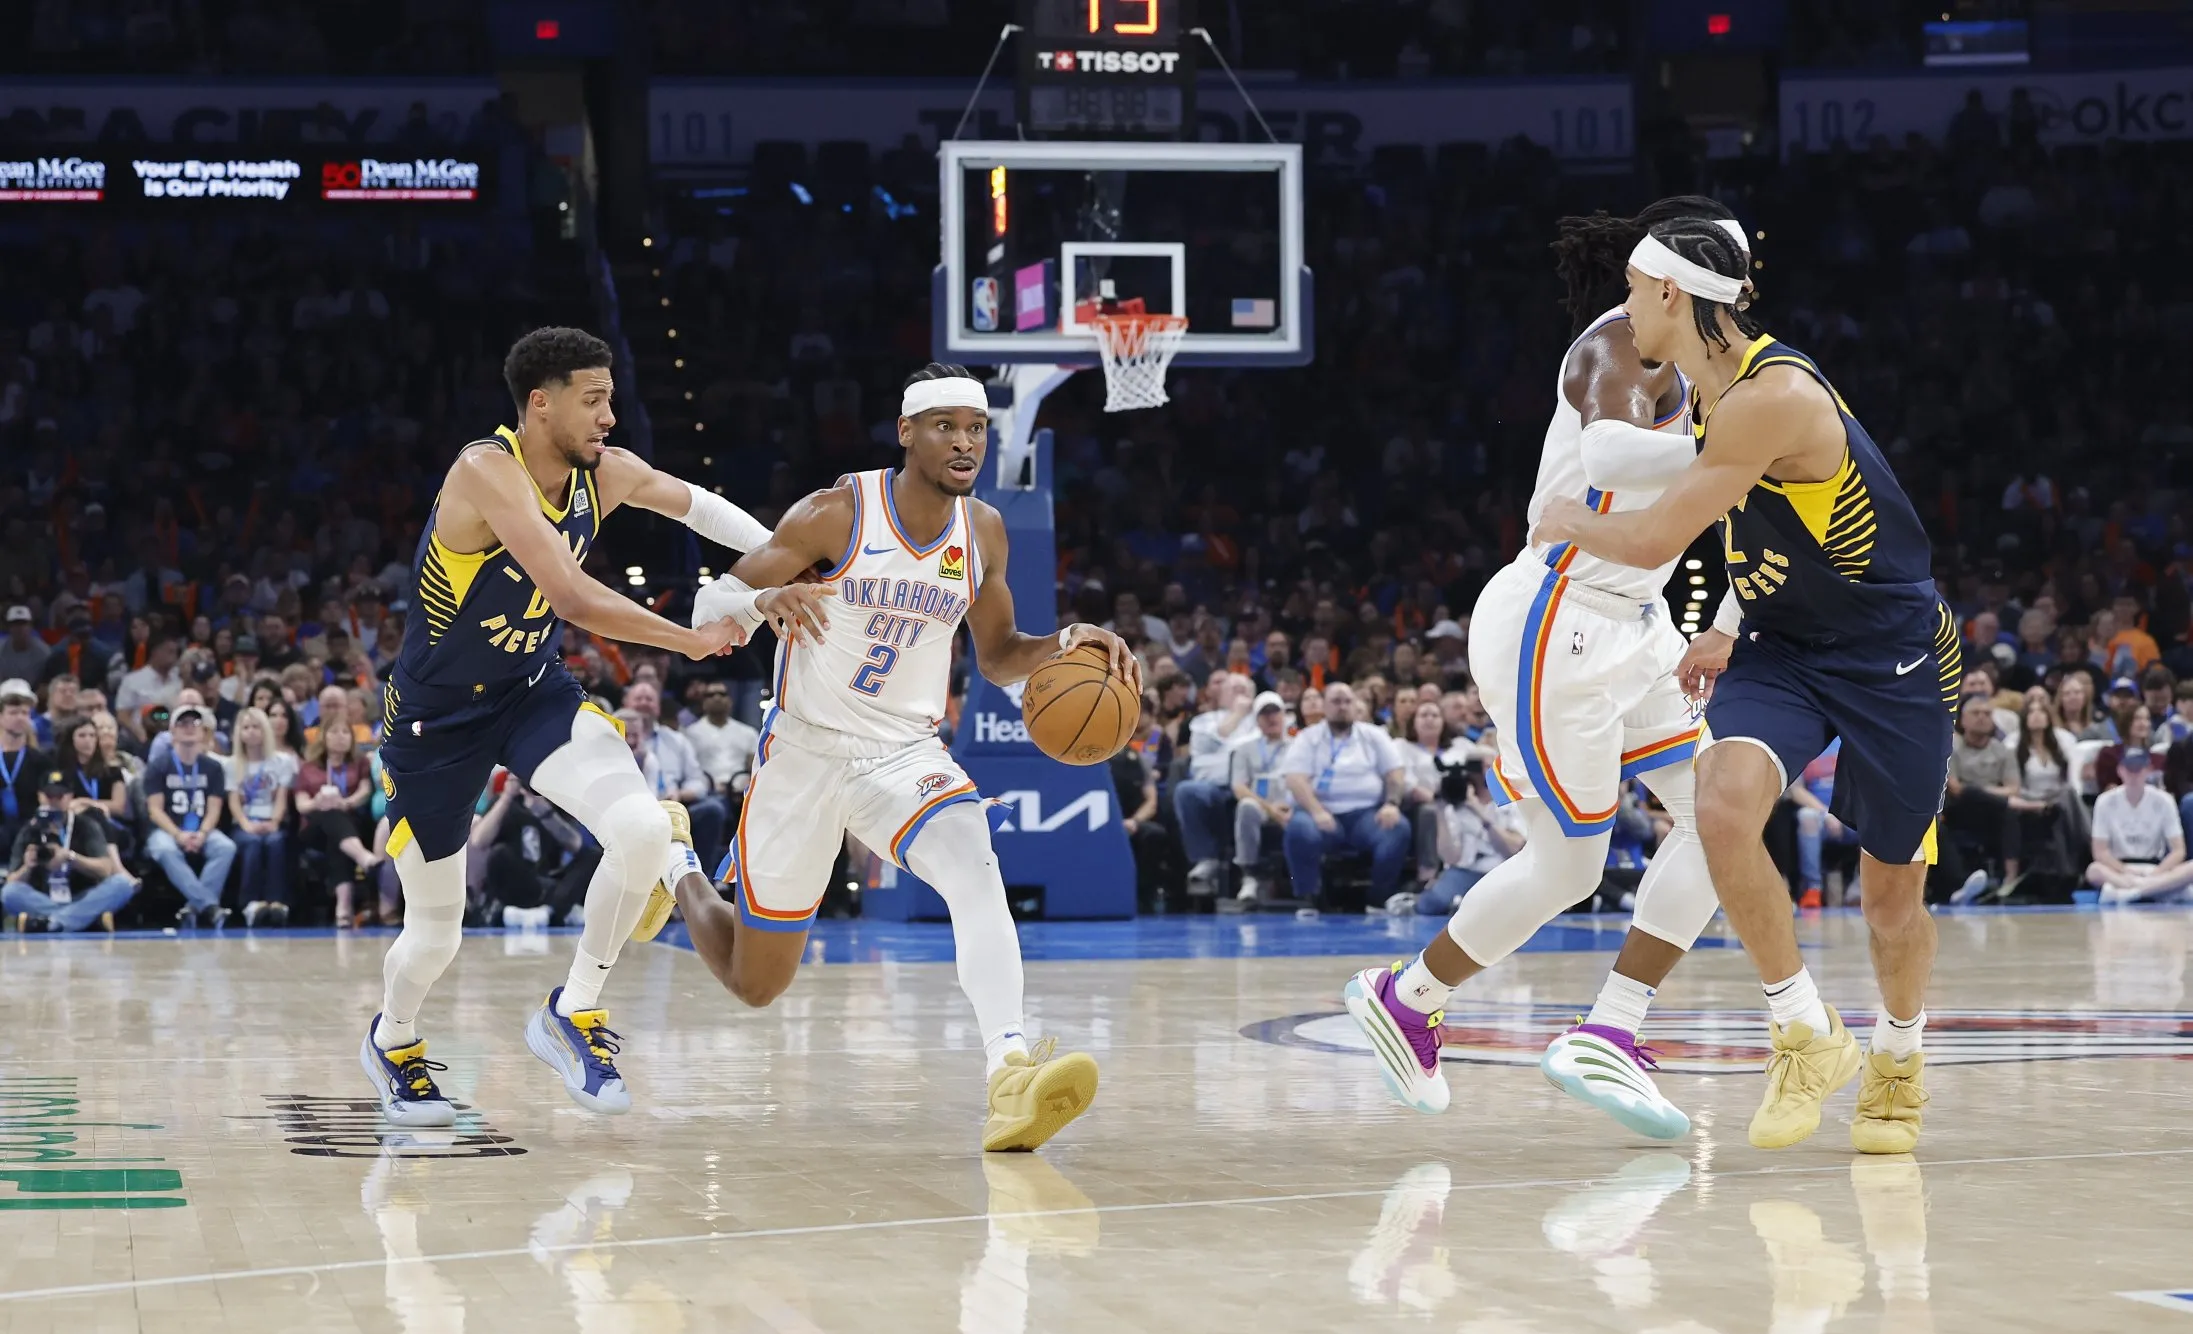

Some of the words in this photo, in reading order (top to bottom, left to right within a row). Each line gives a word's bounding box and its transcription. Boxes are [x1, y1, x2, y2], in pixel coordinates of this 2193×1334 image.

[1075, 51, 1180, 73] TISSOT
[658, 111, 733, 158] 101
[1551, 106, 1625, 154] 101
[132, 160, 183, 178] Your
[184, 160, 226, 181] Eye
[227, 160, 301, 178] Health
[143, 179, 164, 198] Is
[165, 179, 207, 198] Our
[208, 178, 290, 200] Priority
[1735, 548, 1789, 600] CERS
[842, 577, 967, 626] OKLAHOMA
[864, 612, 927, 649] CITY
[849, 643, 899, 697] 2
